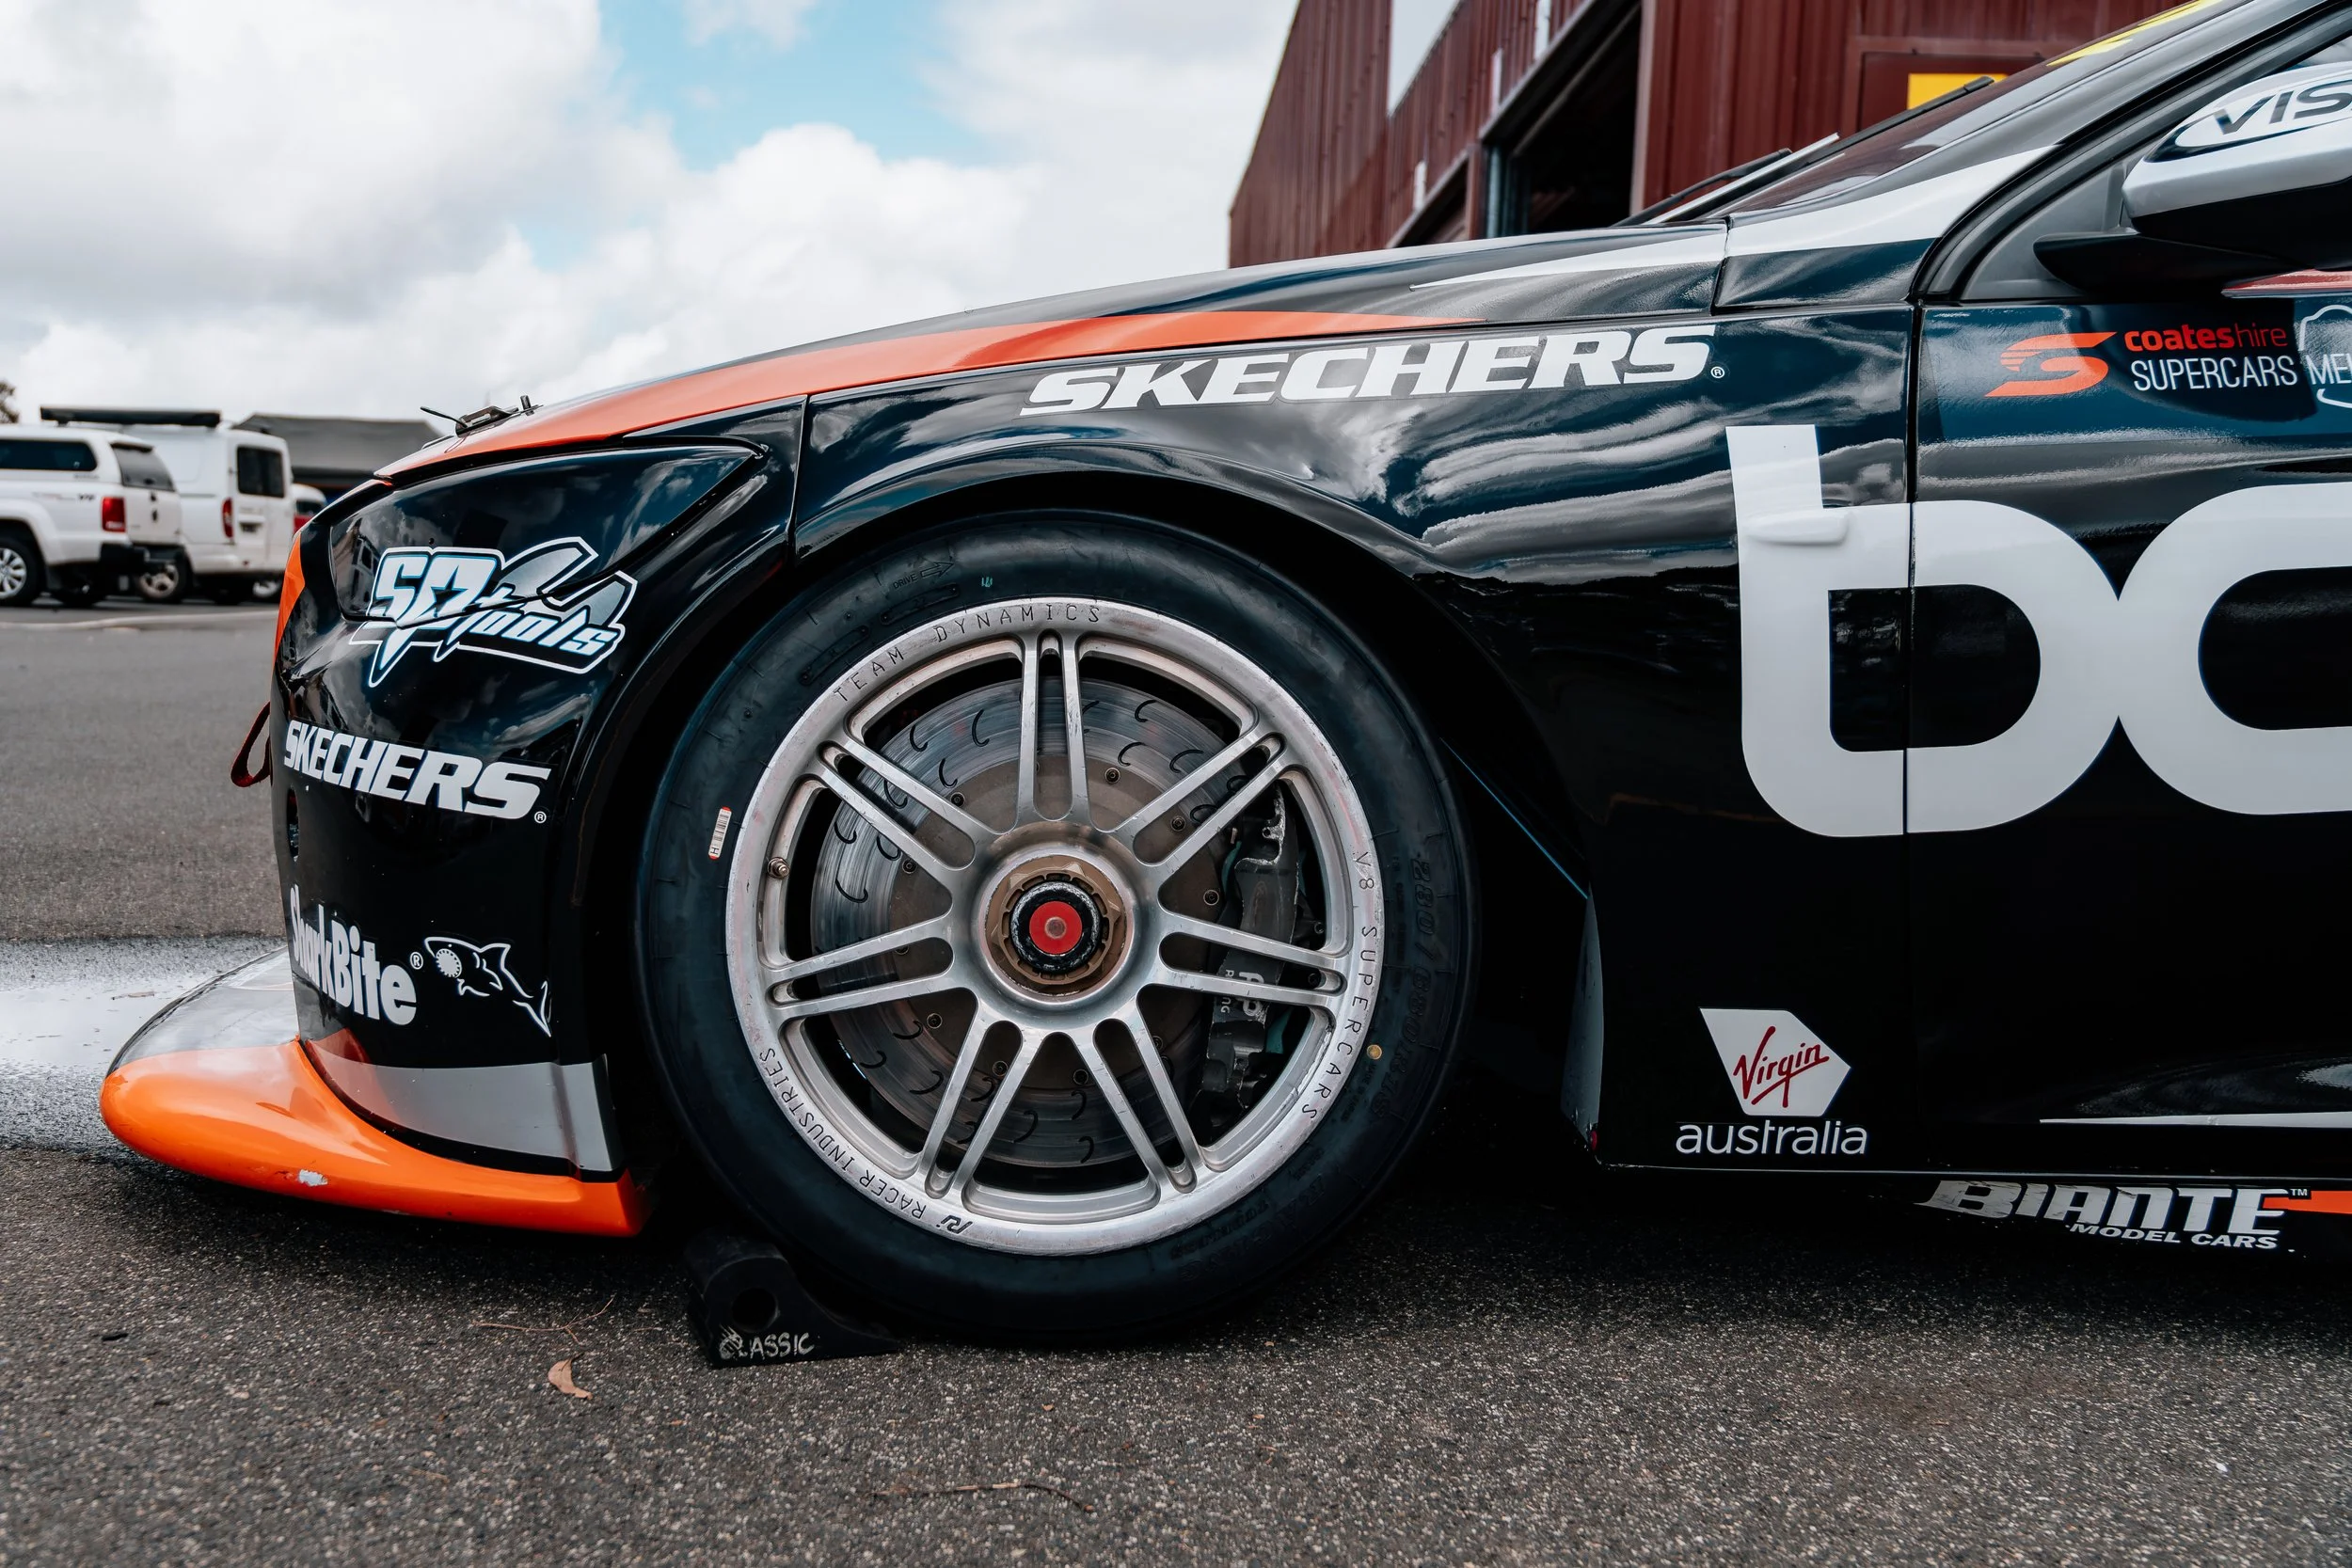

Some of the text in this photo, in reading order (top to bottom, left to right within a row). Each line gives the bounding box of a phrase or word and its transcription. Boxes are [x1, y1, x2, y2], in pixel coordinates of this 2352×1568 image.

[2214, 79, 2352, 135] VIS
[2130, 353, 2352, 391] SUPERCARS ME
[833, 603, 1100, 702] TEAM DYNAMICS
[1353, 851, 1375, 890] V8
[1302, 926, 1378, 1119] SUPERCARS
[1733, 1026, 1830, 1108] Virgin
[760, 1048, 855, 1171] INDUSTRIES
[1676, 1119, 1867, 1155] australia
[859, 1169, 927, 1220] RACER
[2069, 1222, 2279, 1250] MODEL CARS
